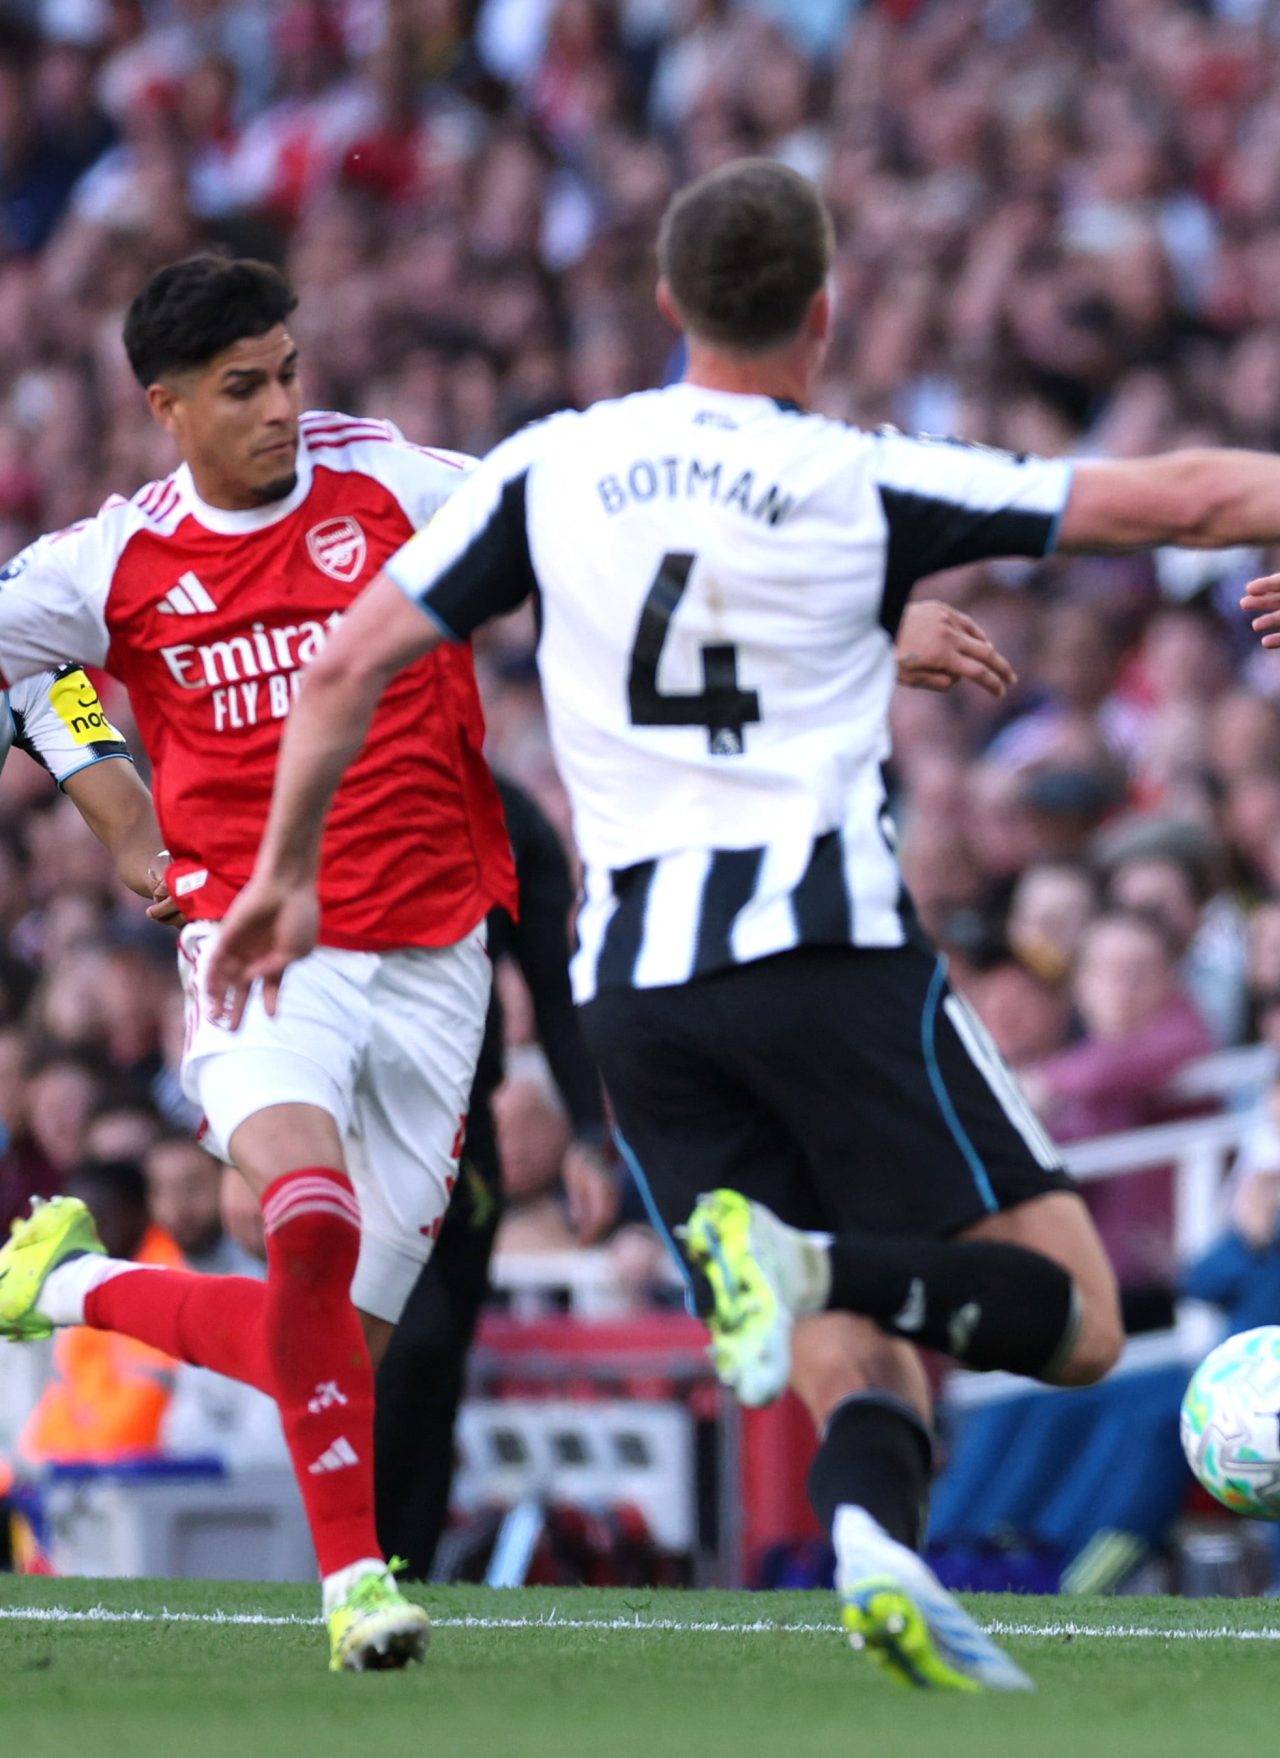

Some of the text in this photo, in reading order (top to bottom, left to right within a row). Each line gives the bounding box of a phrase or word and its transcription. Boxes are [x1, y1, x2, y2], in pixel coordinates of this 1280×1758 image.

[597, 456, 793, 526] BOTMAN
[628, 552, 762, 755] 4
[212, 680, 258, 732] FLY
